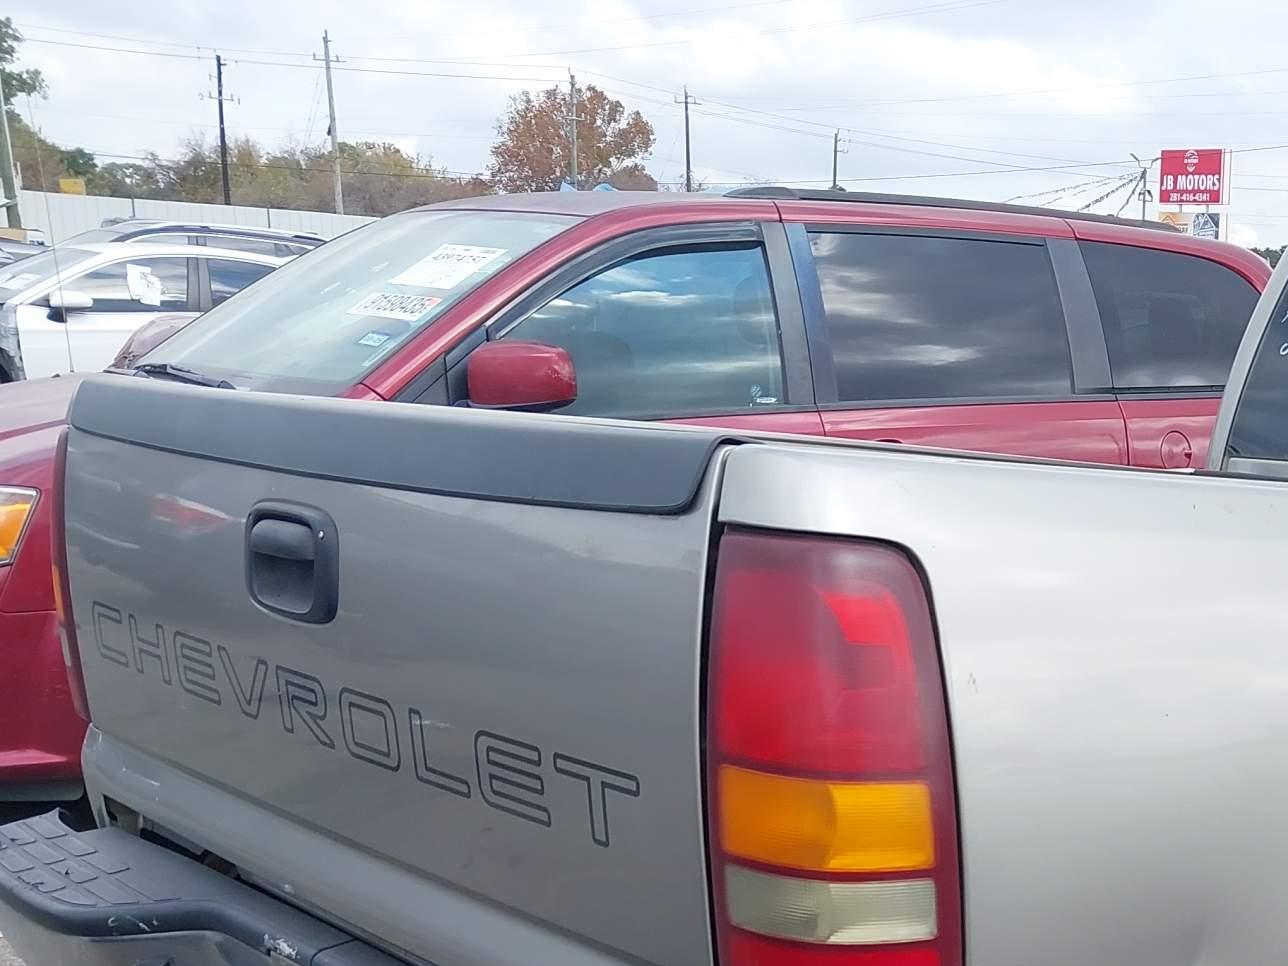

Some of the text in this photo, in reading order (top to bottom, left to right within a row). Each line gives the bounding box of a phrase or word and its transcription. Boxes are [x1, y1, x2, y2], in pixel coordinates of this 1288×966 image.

[1162, 174, 1219, 190] JB MOTORS
[91, 600, 640, 848] CHEVROLET
